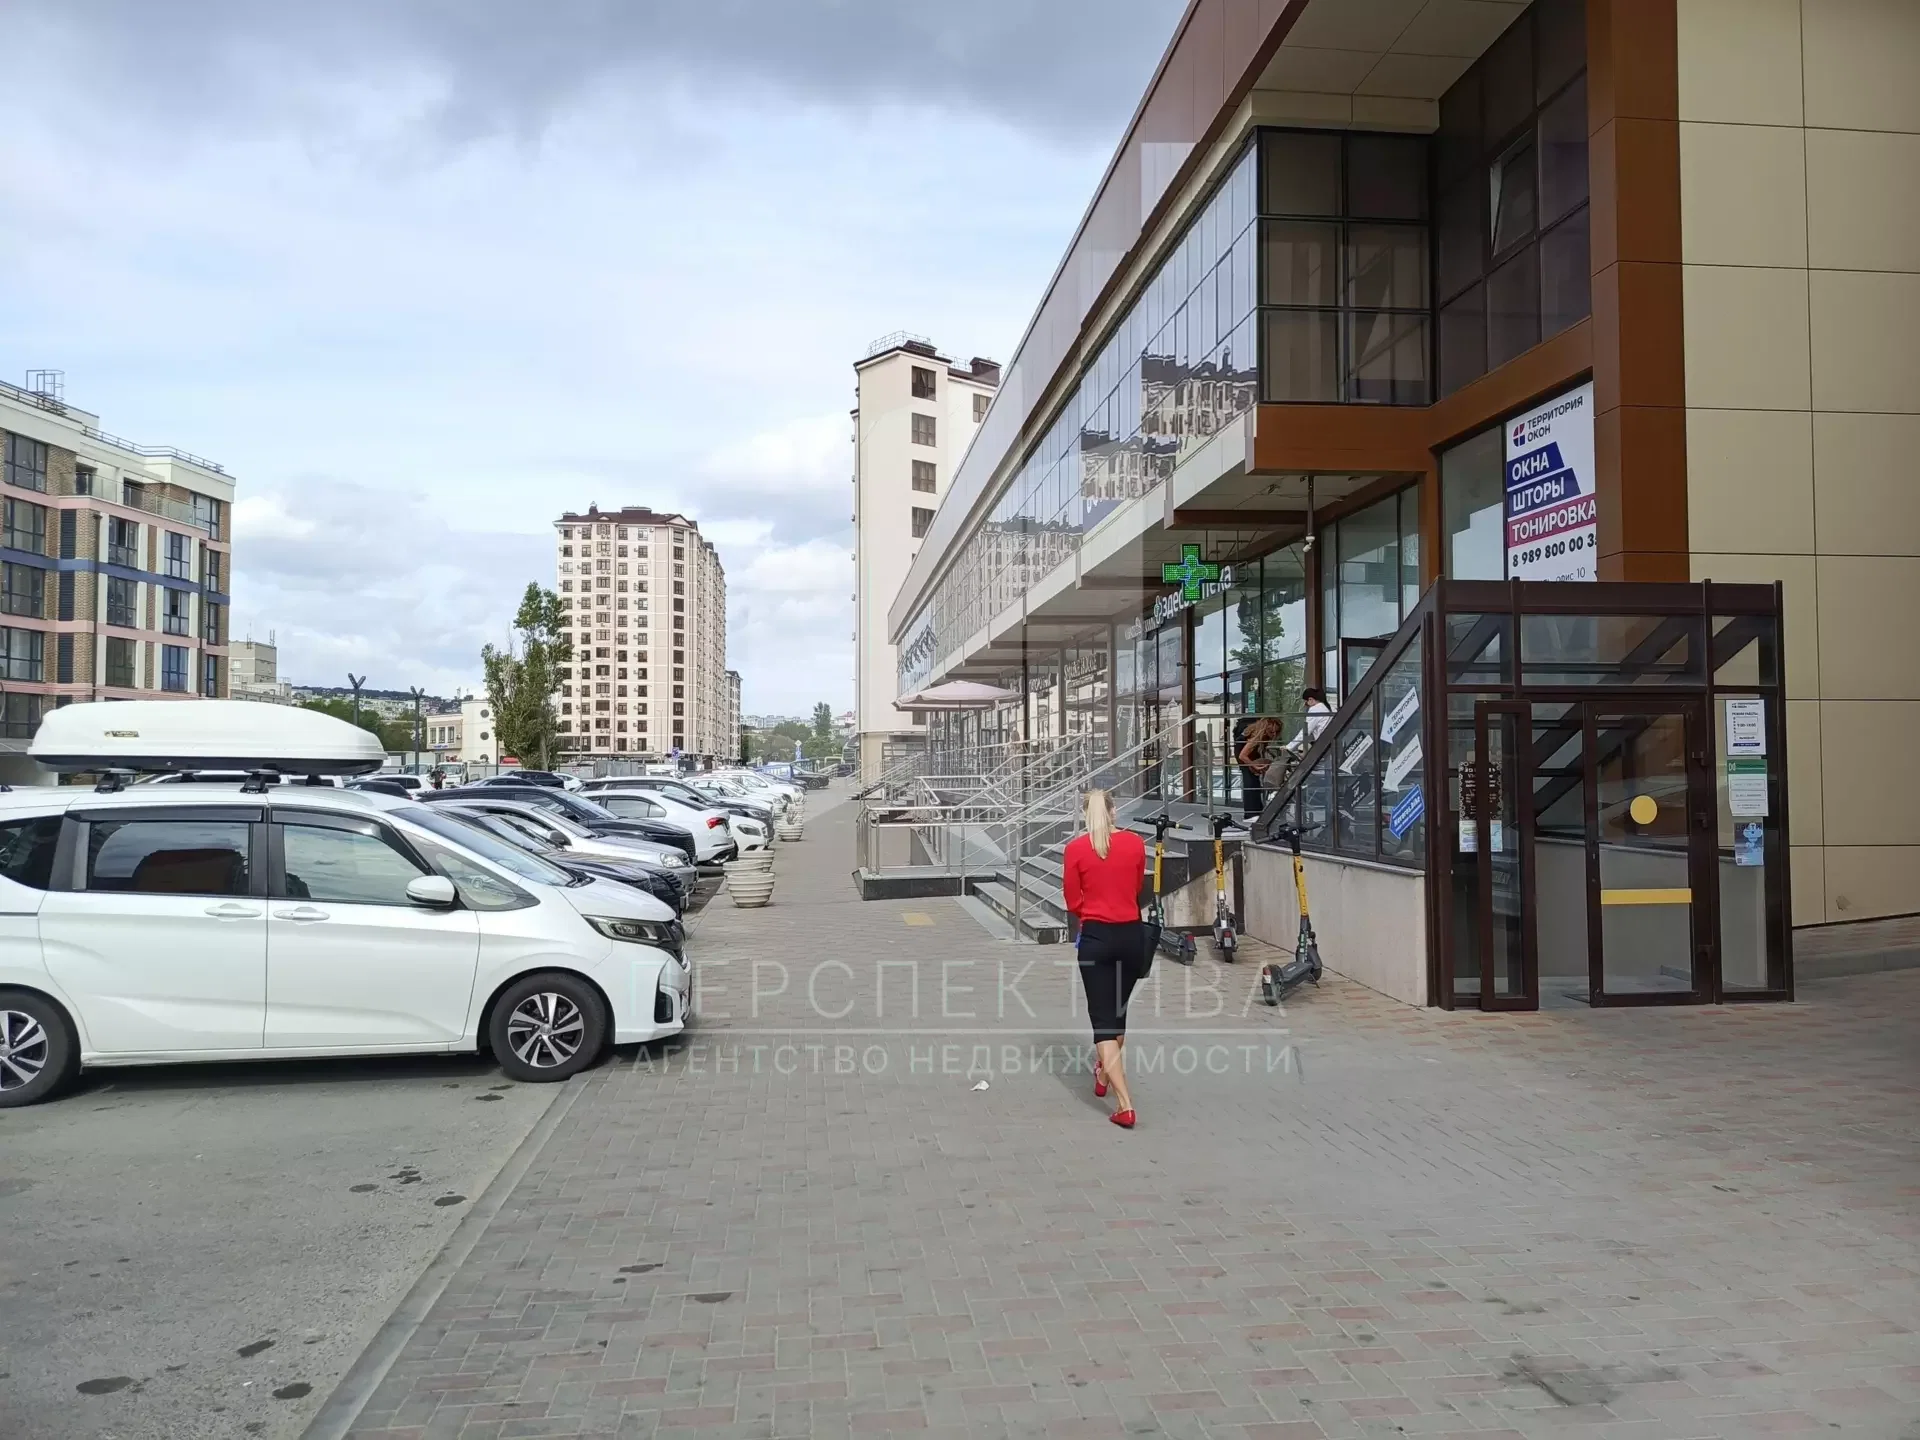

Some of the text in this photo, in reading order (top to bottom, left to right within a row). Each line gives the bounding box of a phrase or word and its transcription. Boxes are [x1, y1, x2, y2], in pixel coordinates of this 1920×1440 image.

[1527, 395, 1584, 430] ТЕРРИТОРИЯ
[1527, 423, 1551, 442] ОКОН
[1512, 451, 1550, 480] ОКНА
[1512, 476, 1565, 512] ШТОРЫ
[1512, 499, 1597, 542] ТОНИРОВКА
[1512, 532, 1597, 567] 8 989 800 00 3
[1576, 566, 1586, 579] 10
[1393, 714, 1404, 729] ОКОН
